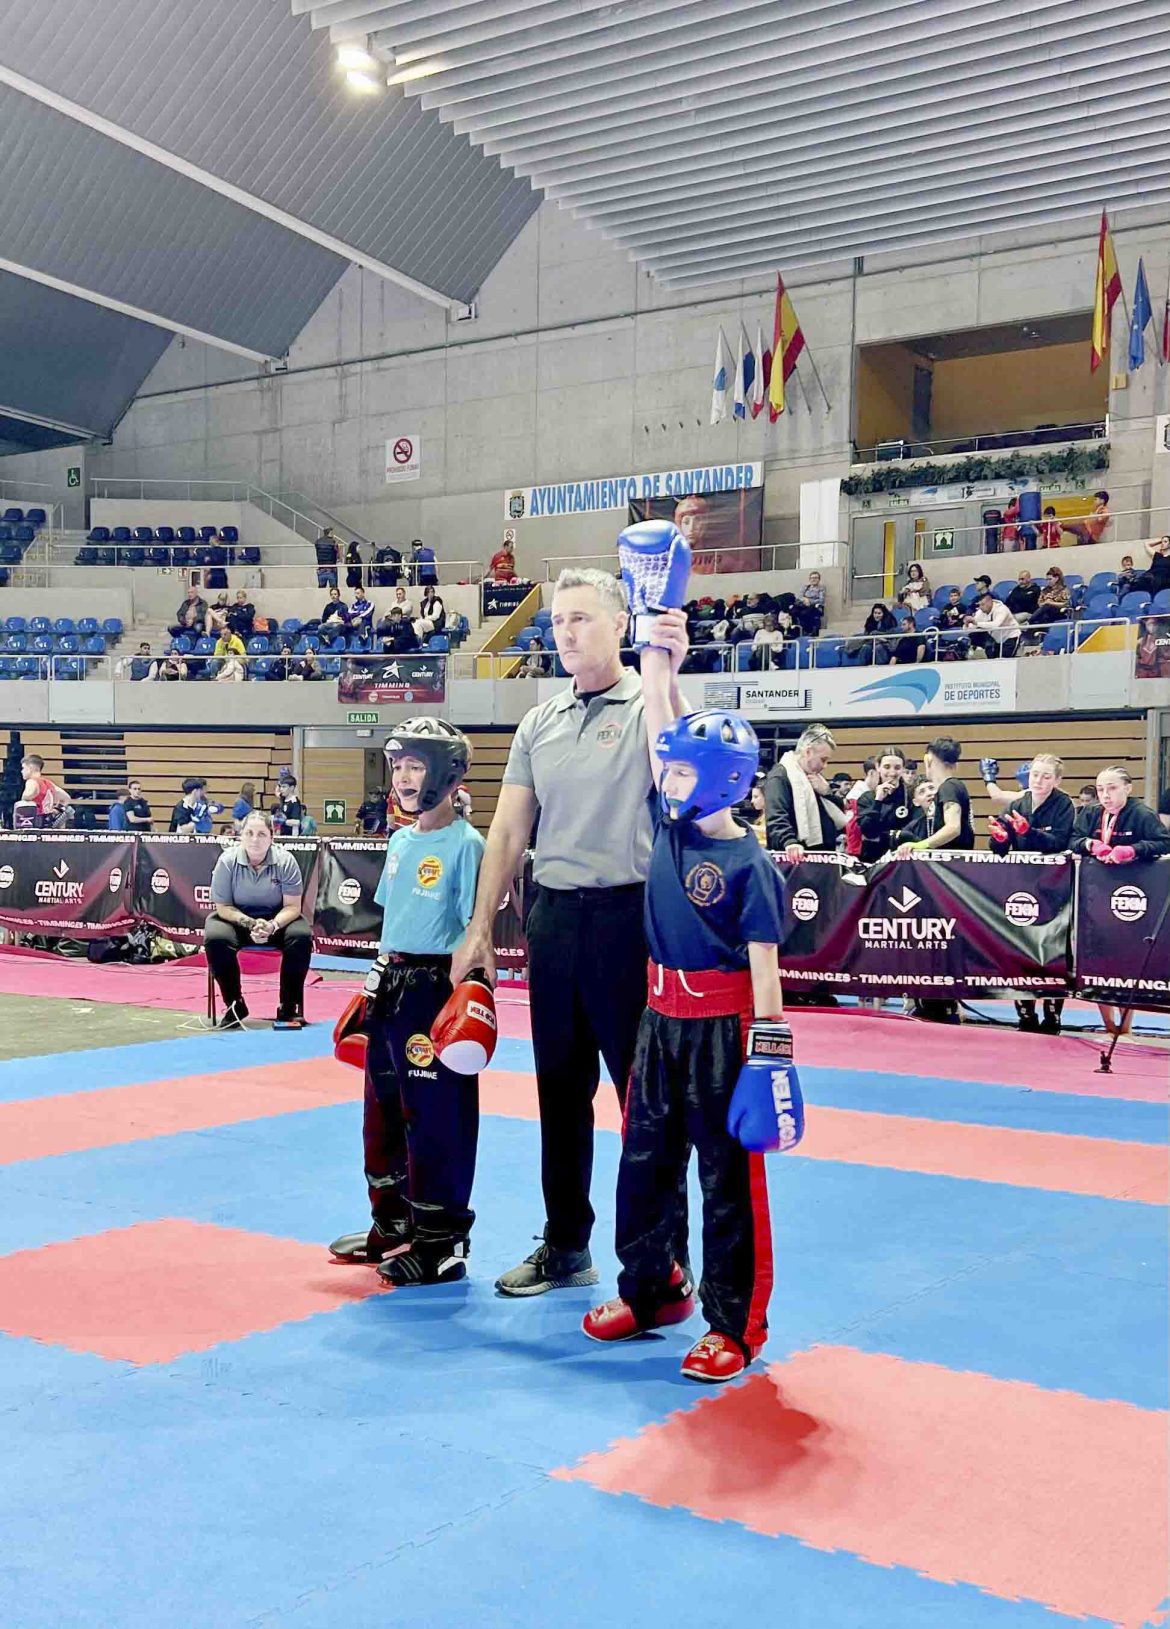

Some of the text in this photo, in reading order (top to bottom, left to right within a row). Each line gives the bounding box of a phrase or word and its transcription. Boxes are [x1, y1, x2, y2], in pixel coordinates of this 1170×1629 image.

[530, 464, 754, 516] AYUNTAMIENTO DE SANTANDER
[745, 689, 800, 699] SANTANDER
[944, 688, 1001, 701] DE DEPORTES
[350, 713, 378, 723] SALIDA
[35, 881, 84, 897] CENTURY
[857, 917, 957, 940] CENTURY
[864, 940, 948, 950] MARTIAL ARTS
[770, 1069, 795, 1115] TEN
